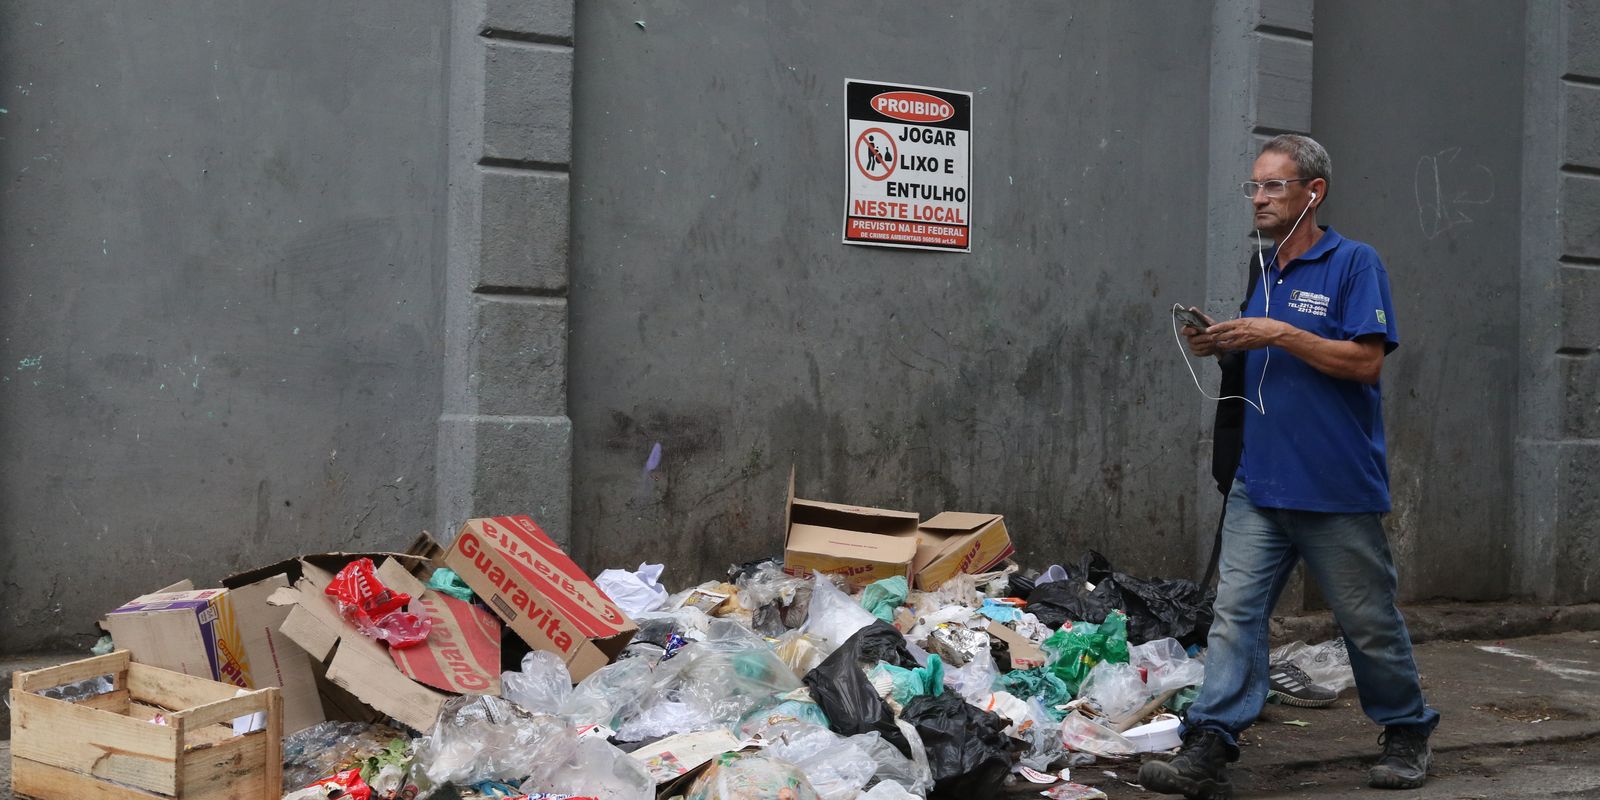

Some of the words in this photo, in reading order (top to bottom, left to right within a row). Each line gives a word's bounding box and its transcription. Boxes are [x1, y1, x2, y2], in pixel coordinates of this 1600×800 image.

[877, 97, 950, 118] PROIBIDO
[898, 126, 956, 146] JOGAR
[900, 154, 939, 173] LIXO
[944, 159, 954, 174] E
[886, 181, 966, 203] ENTULHO
[854, 199, 908, 219] NESTE
[913, 204, 964, 224] LOCAL
[852, 220, 896, 231] PREVISTO
[898, 222, 911, 233] NA
[912, 224, 926, 234] LEI
[927, 225, 964, 237] FEDERAL
[869, 232, 890, 240] CRIMES
[890, 233, 922, 242] AMBIENTAIS
[458, 533, 573, 653] Guaravita
